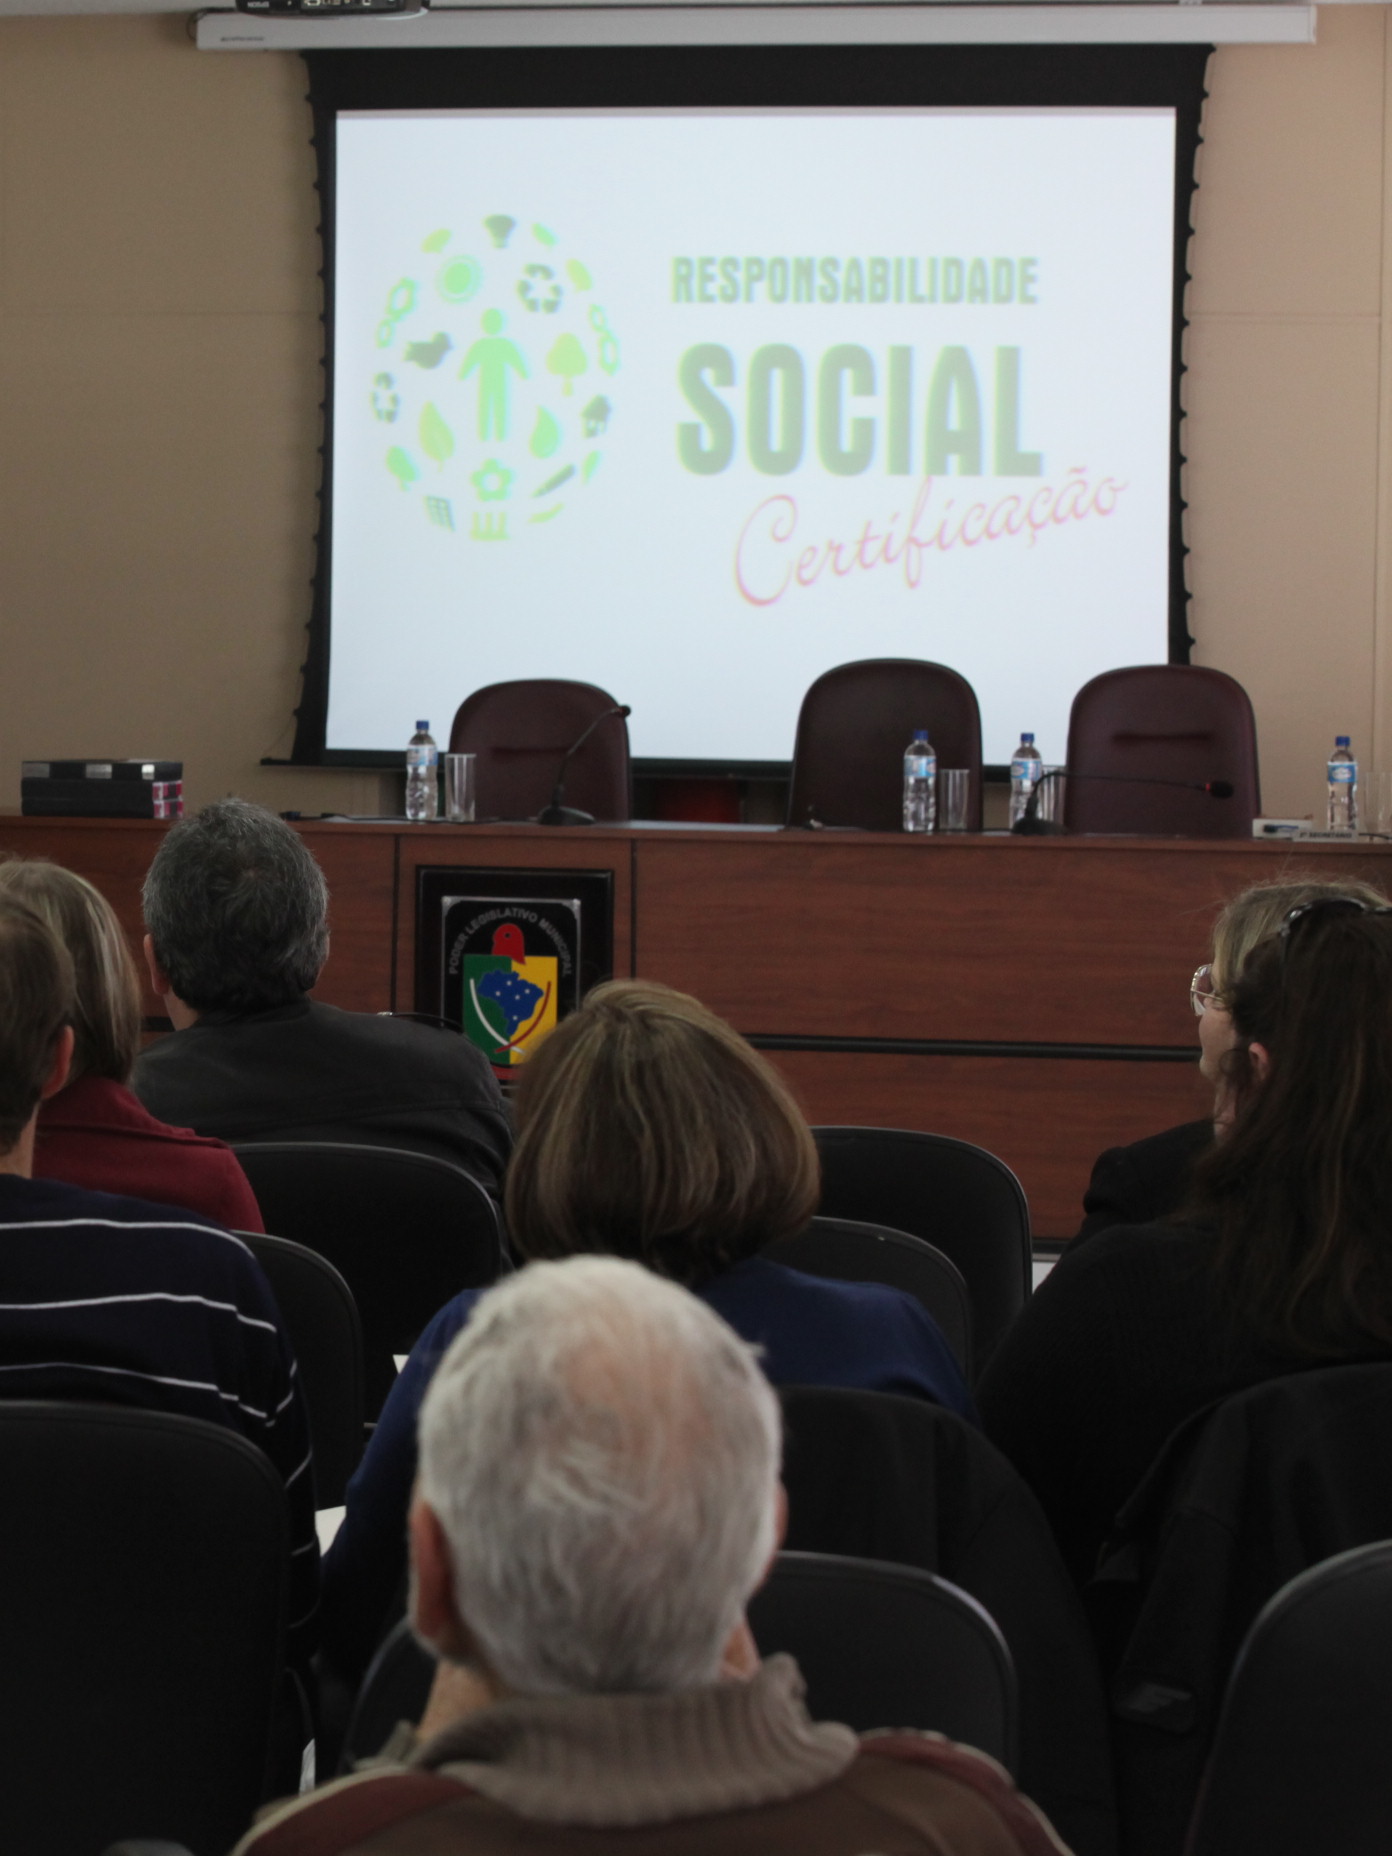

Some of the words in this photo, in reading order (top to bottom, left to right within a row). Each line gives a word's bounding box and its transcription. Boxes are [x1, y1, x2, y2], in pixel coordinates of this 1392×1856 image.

[671, 256, 1040, 304] RESPONSABILIDADE
[675, 342, 1045, 477] SOCIAL
[733, 467, 1129, 607] Certificação
[449, 932, 469, 975] PODER
[465, 907, 538, 936] LEGISLATIVO
[538, 918, 572, 978] MUNICIPAL
